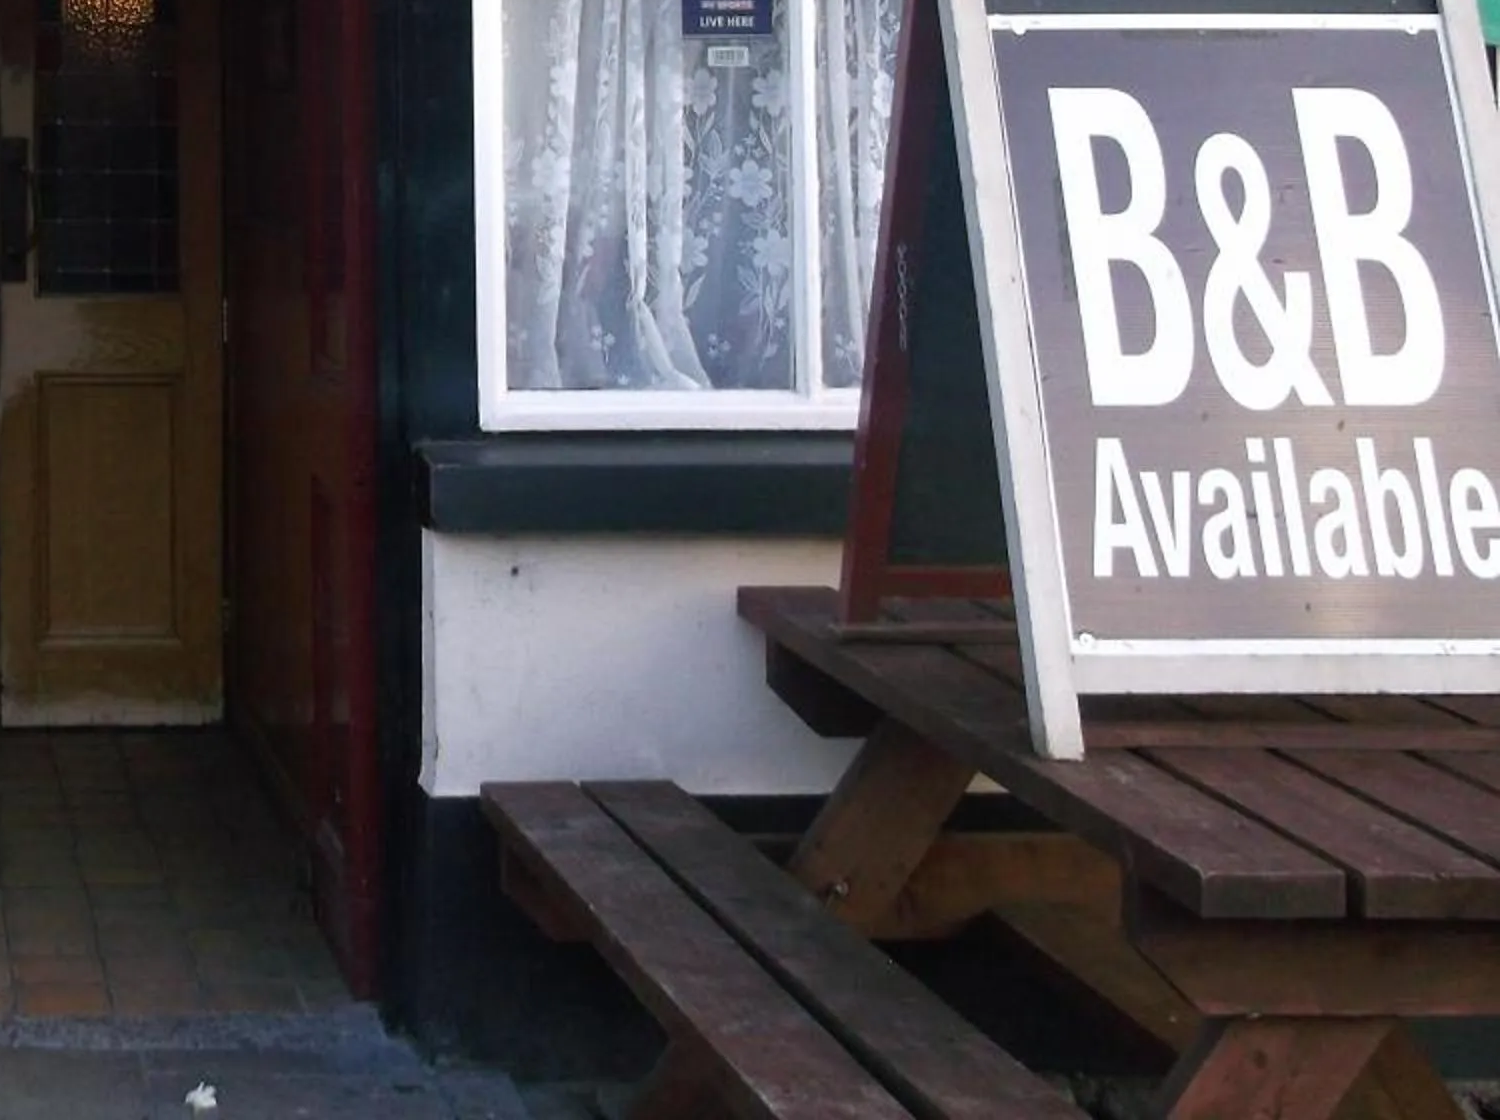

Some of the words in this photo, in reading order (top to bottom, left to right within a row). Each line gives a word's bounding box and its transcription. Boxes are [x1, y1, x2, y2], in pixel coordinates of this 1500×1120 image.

[700, 16, 724, 28] LIVE
[1047, 87, 1446, 411] B&B
[1093, 437, 1500, 579] Available
